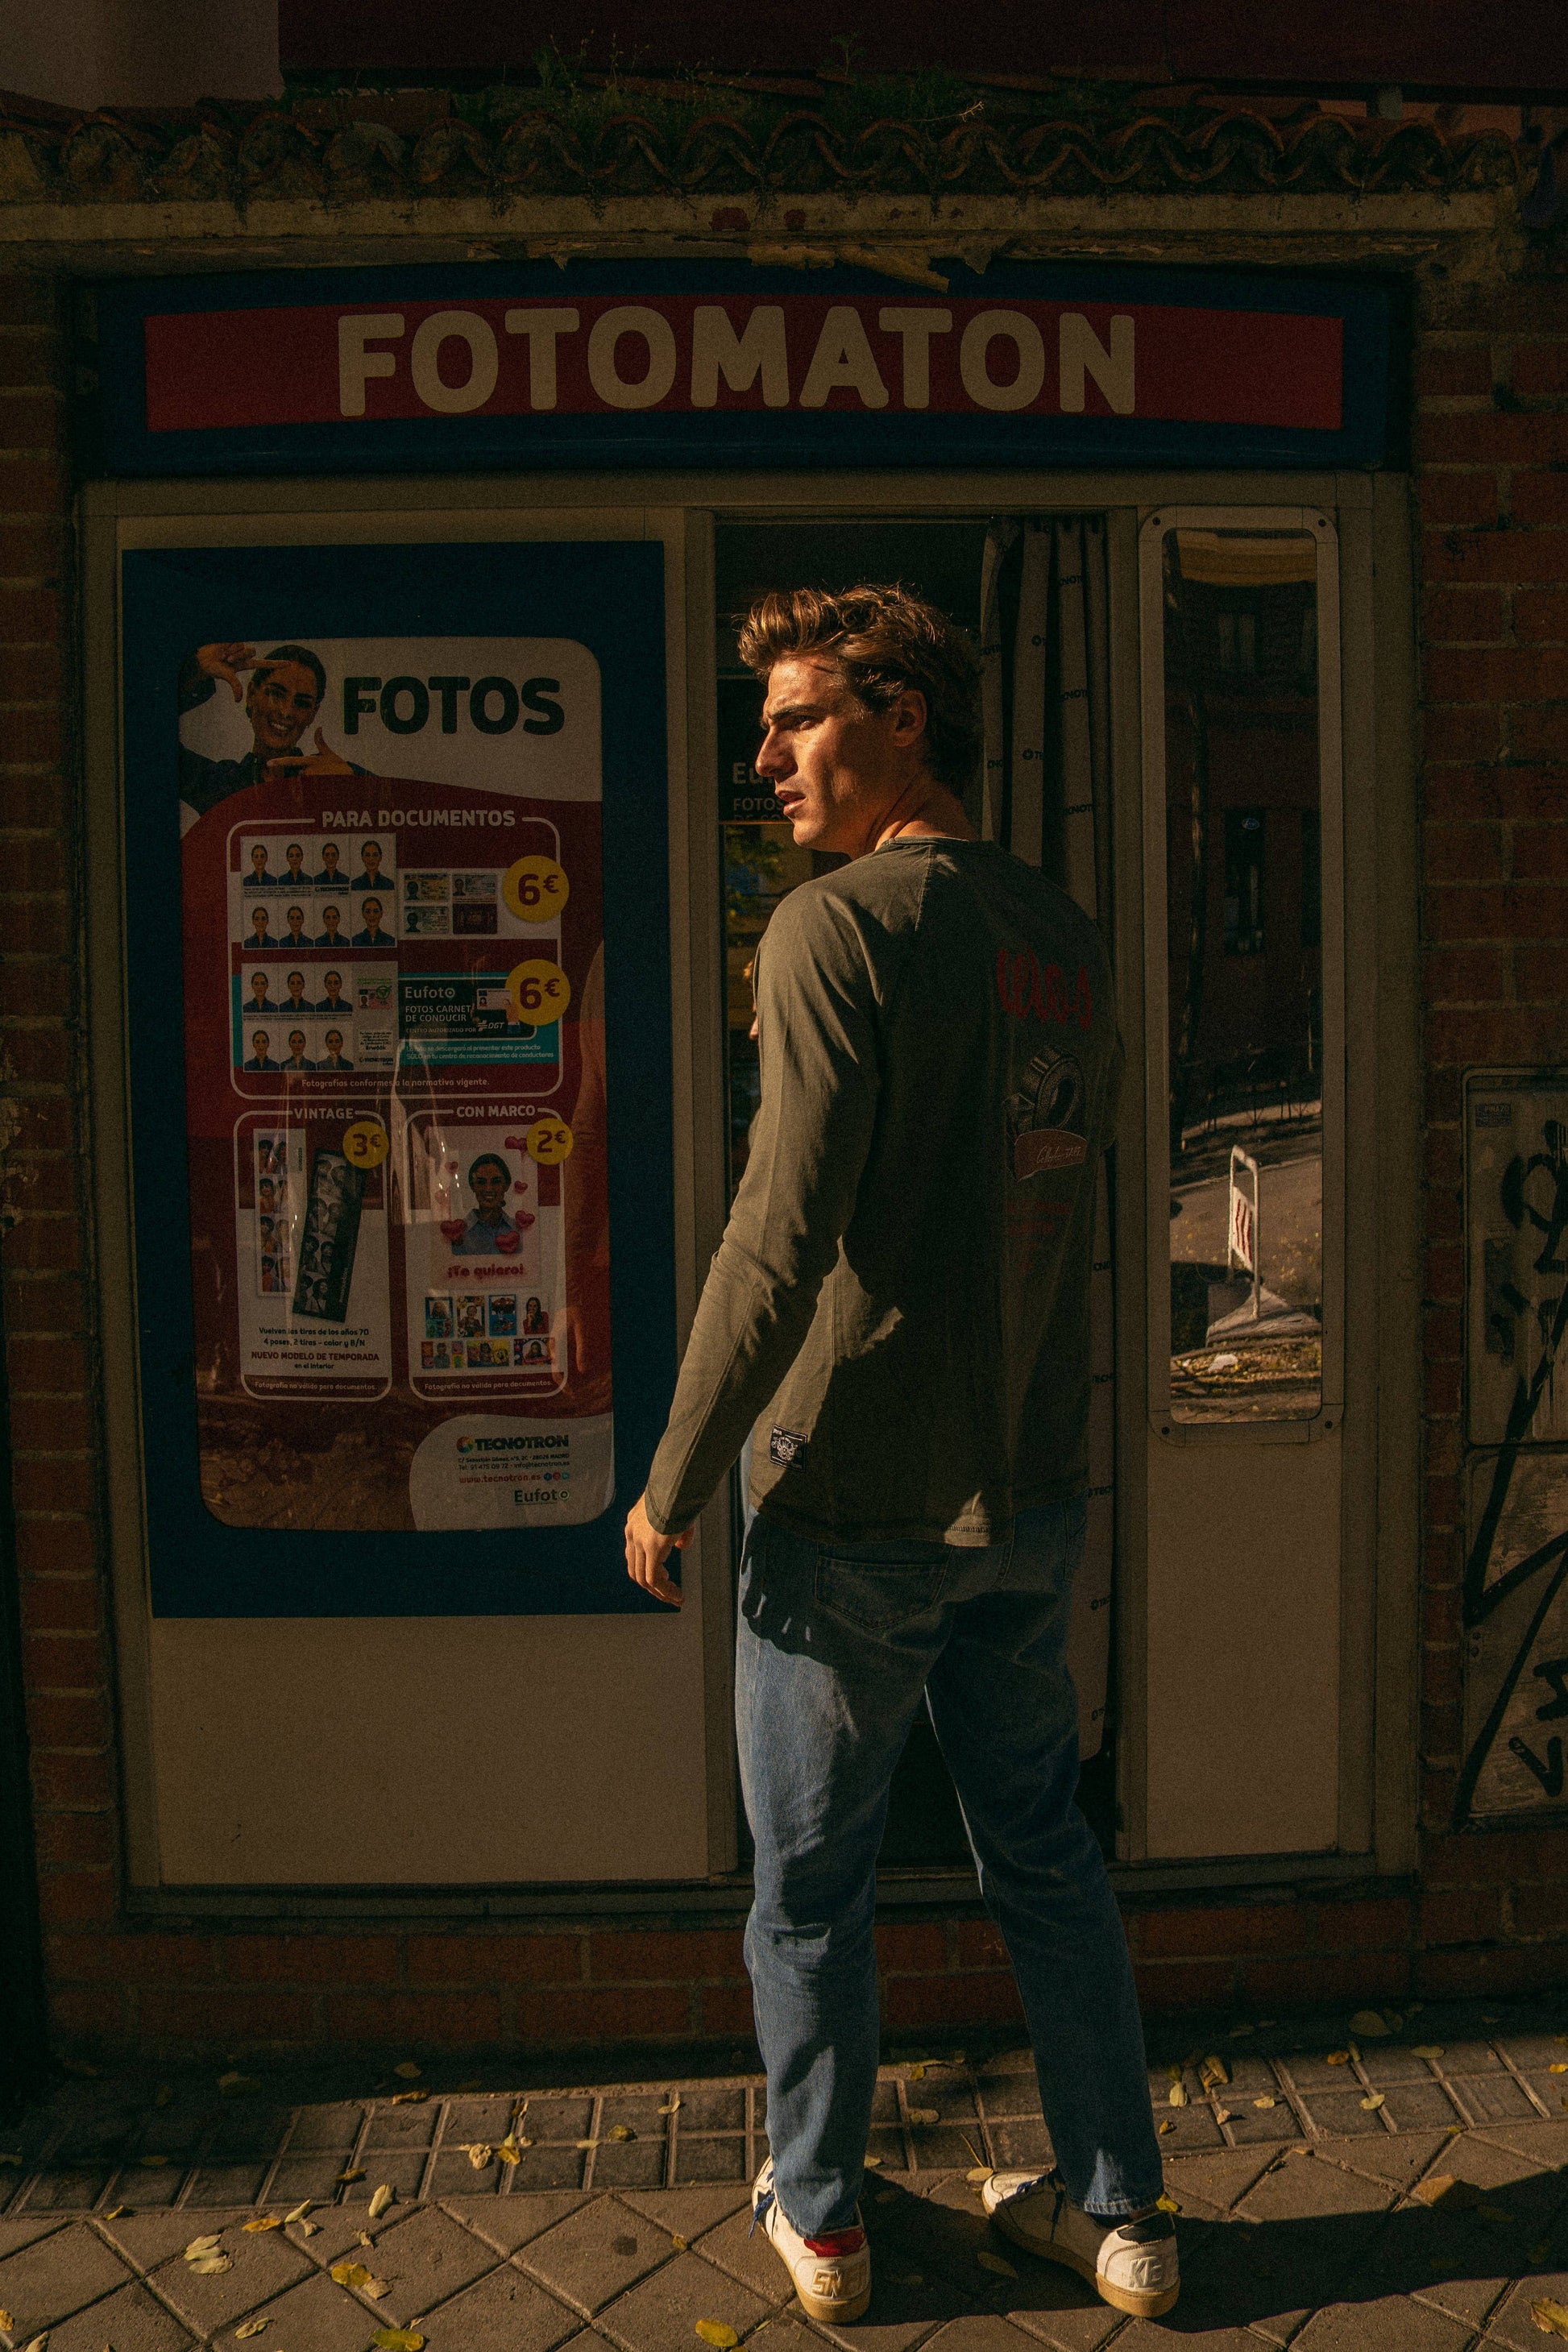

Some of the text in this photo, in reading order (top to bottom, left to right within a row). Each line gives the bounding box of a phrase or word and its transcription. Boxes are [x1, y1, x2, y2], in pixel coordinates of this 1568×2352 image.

[338, 305, 1135, 417] FOTOMATON
[343, 676, 565, 735] FOTOS
[322, 809, 516, 828] PARA DOCUMENTOS
[518, 873, 559, 906] 6€
[404, 985, 456, 999] Eufoto
[520, 977, 561, 1010] 6€
[405, 1005, 471, 1014] FOTOS CARNET
[405, 1014, 467, 1023] DE CONDUCIR
[487, 1022, 505, 1030] DGT
[302, 1079, 348, 1089] Fotografías
[413, 1078, 454, 1087] normativa
[456, 1078, 490, 1088] vigente.
[293, 1107, 354, 1120] VINTAGE
[456, 1105, 536, 1118] CON MARCO
[353, 1133, 381, 1157] 3€
[537, 1130, 566, 1153] 2€
[448, 1263, 524, 1280] ¡Te quiero!
[341, 1328, 358, 1336] años
[270, 1338, 292, 1346] poses,
[351, 1339, 365, 1348] B/N
[251, 1351, 279, 1359] NUEVO
[281, 1352, 314, 1360] MODELO
[329, 1353, 380, 1361] TEMPORADA
[475, 1435, 569, 1450] TECNOTRON
[459, 1474, 541, 1483] www.tecnotron.es
[514, 1488, 570, 1503] Eufoto
